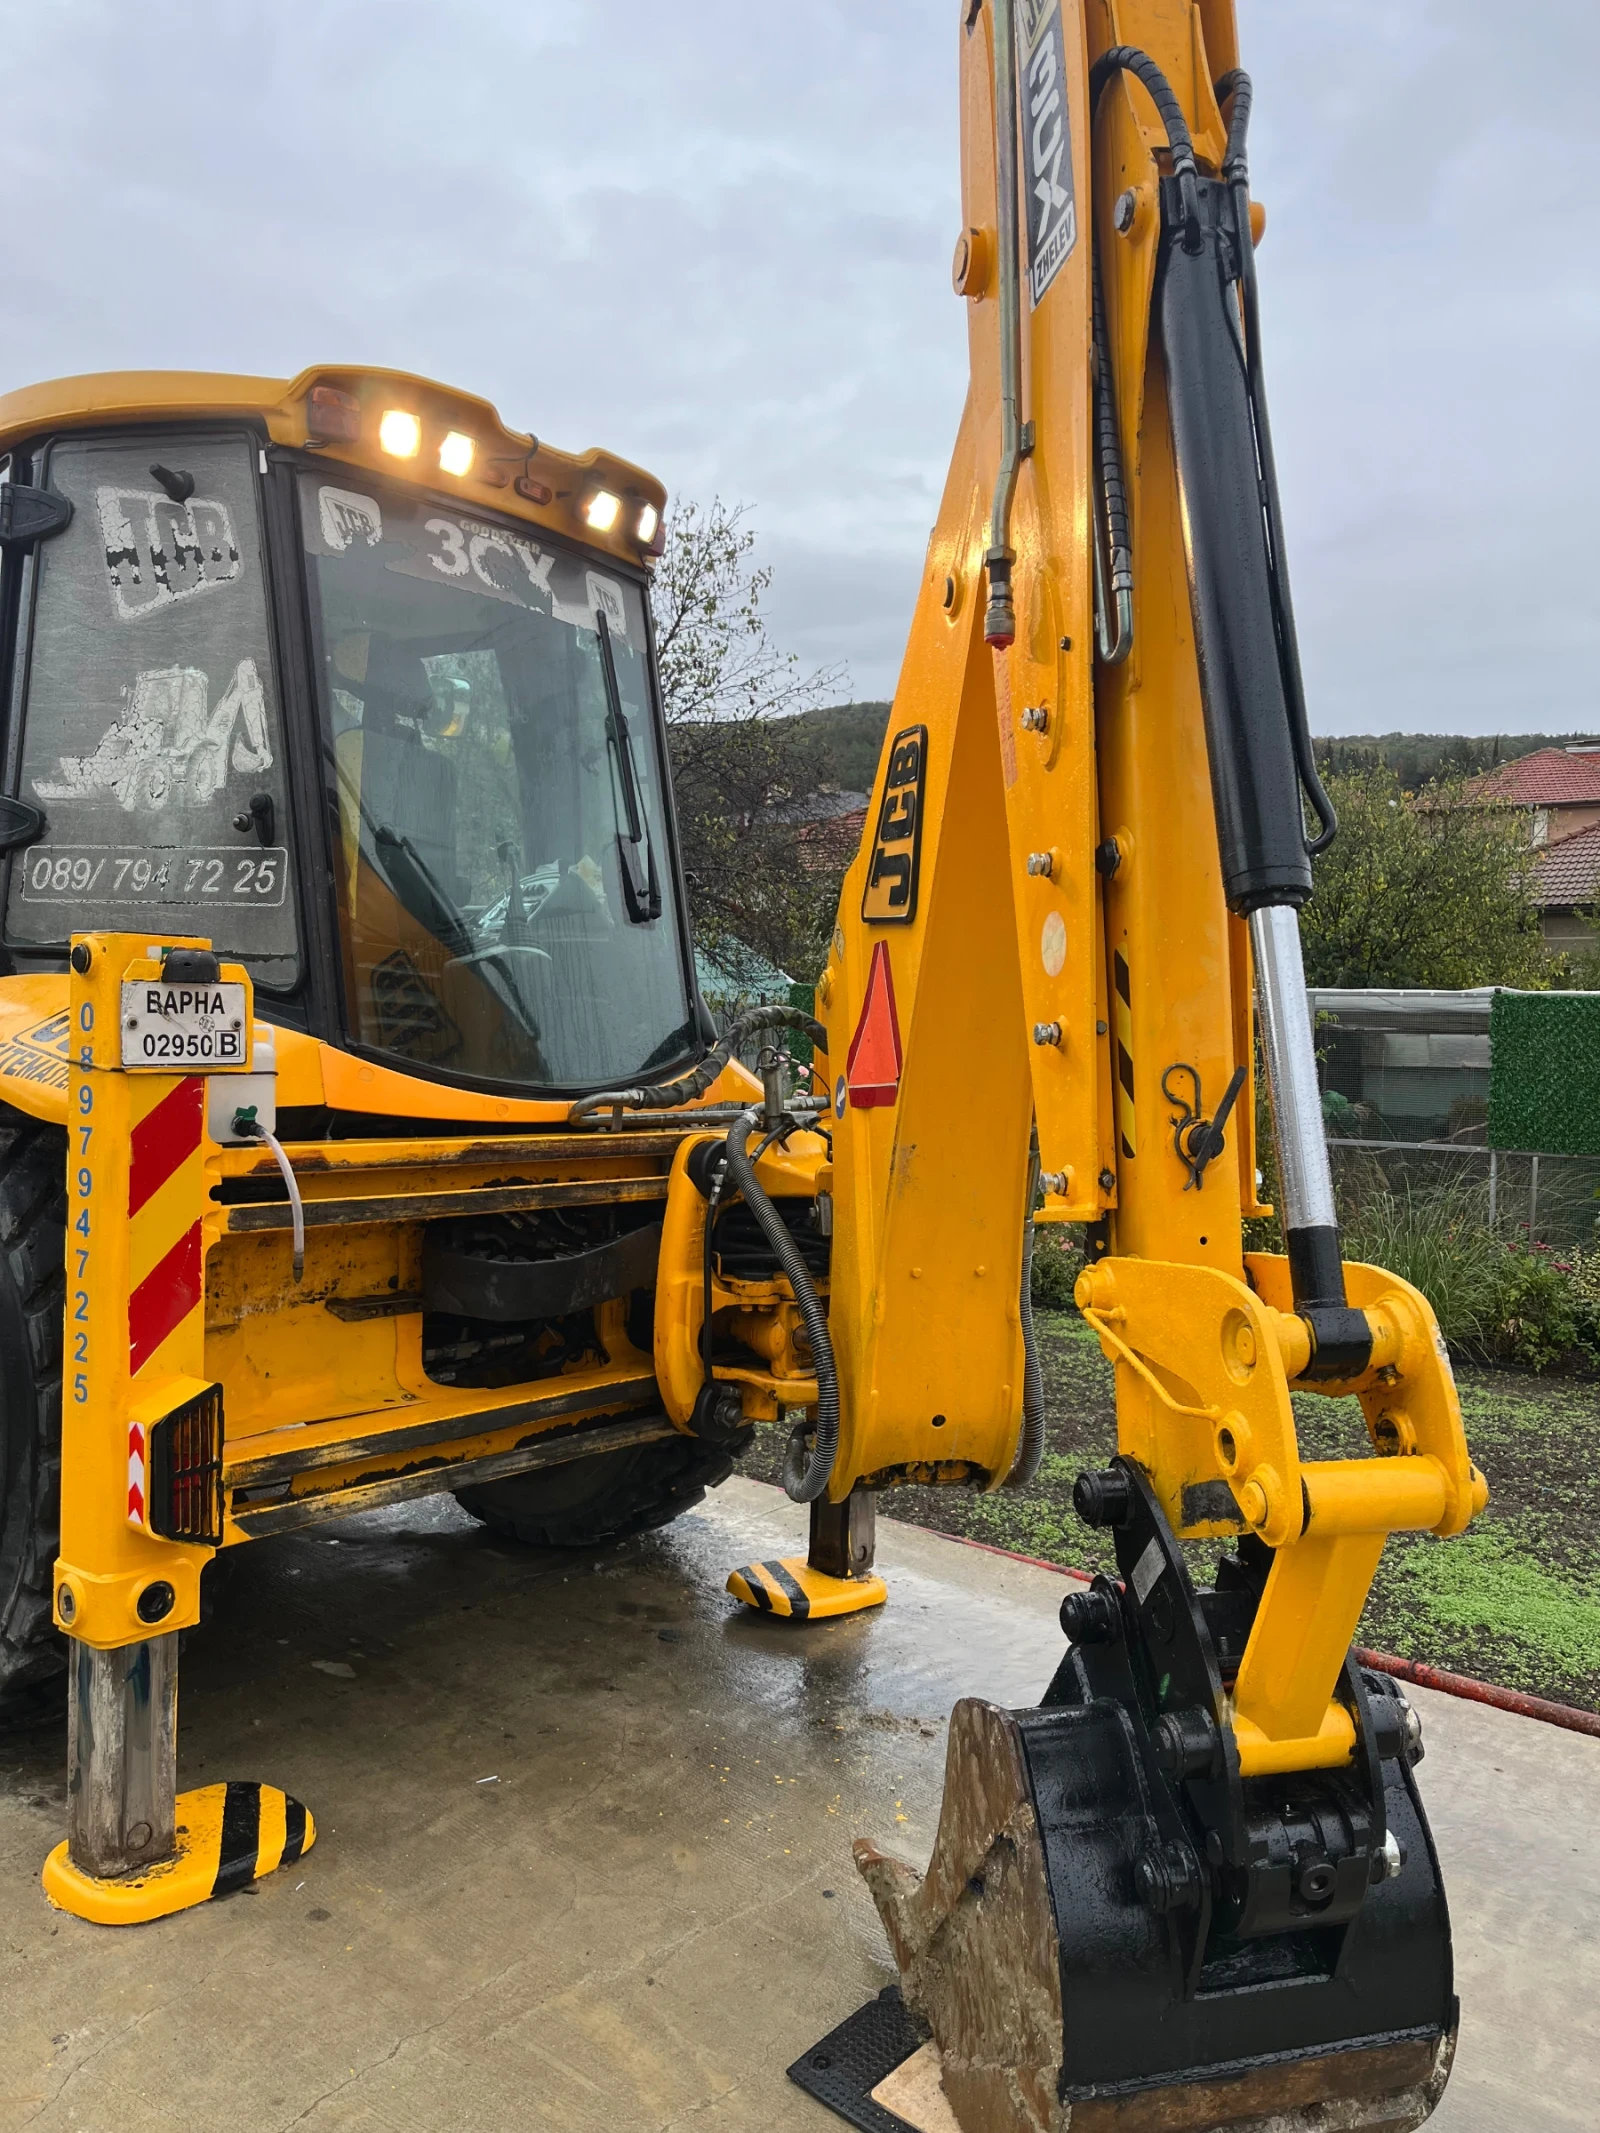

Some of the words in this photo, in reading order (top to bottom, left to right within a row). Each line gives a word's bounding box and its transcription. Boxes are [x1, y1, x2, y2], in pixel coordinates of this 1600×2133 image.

[1029, 30, 1070, 246] 3CX
[1036, 210, 1072, 289] ZHELEV
[334, 502, 375, 538] JCB
[870, 740, 920, 906] JCB
[31, 856, 107, 892] 089/
[113, 857, 173, 893] 794
[183, 858, 225, 893] 72
[233, 858, 278, 894] 25
